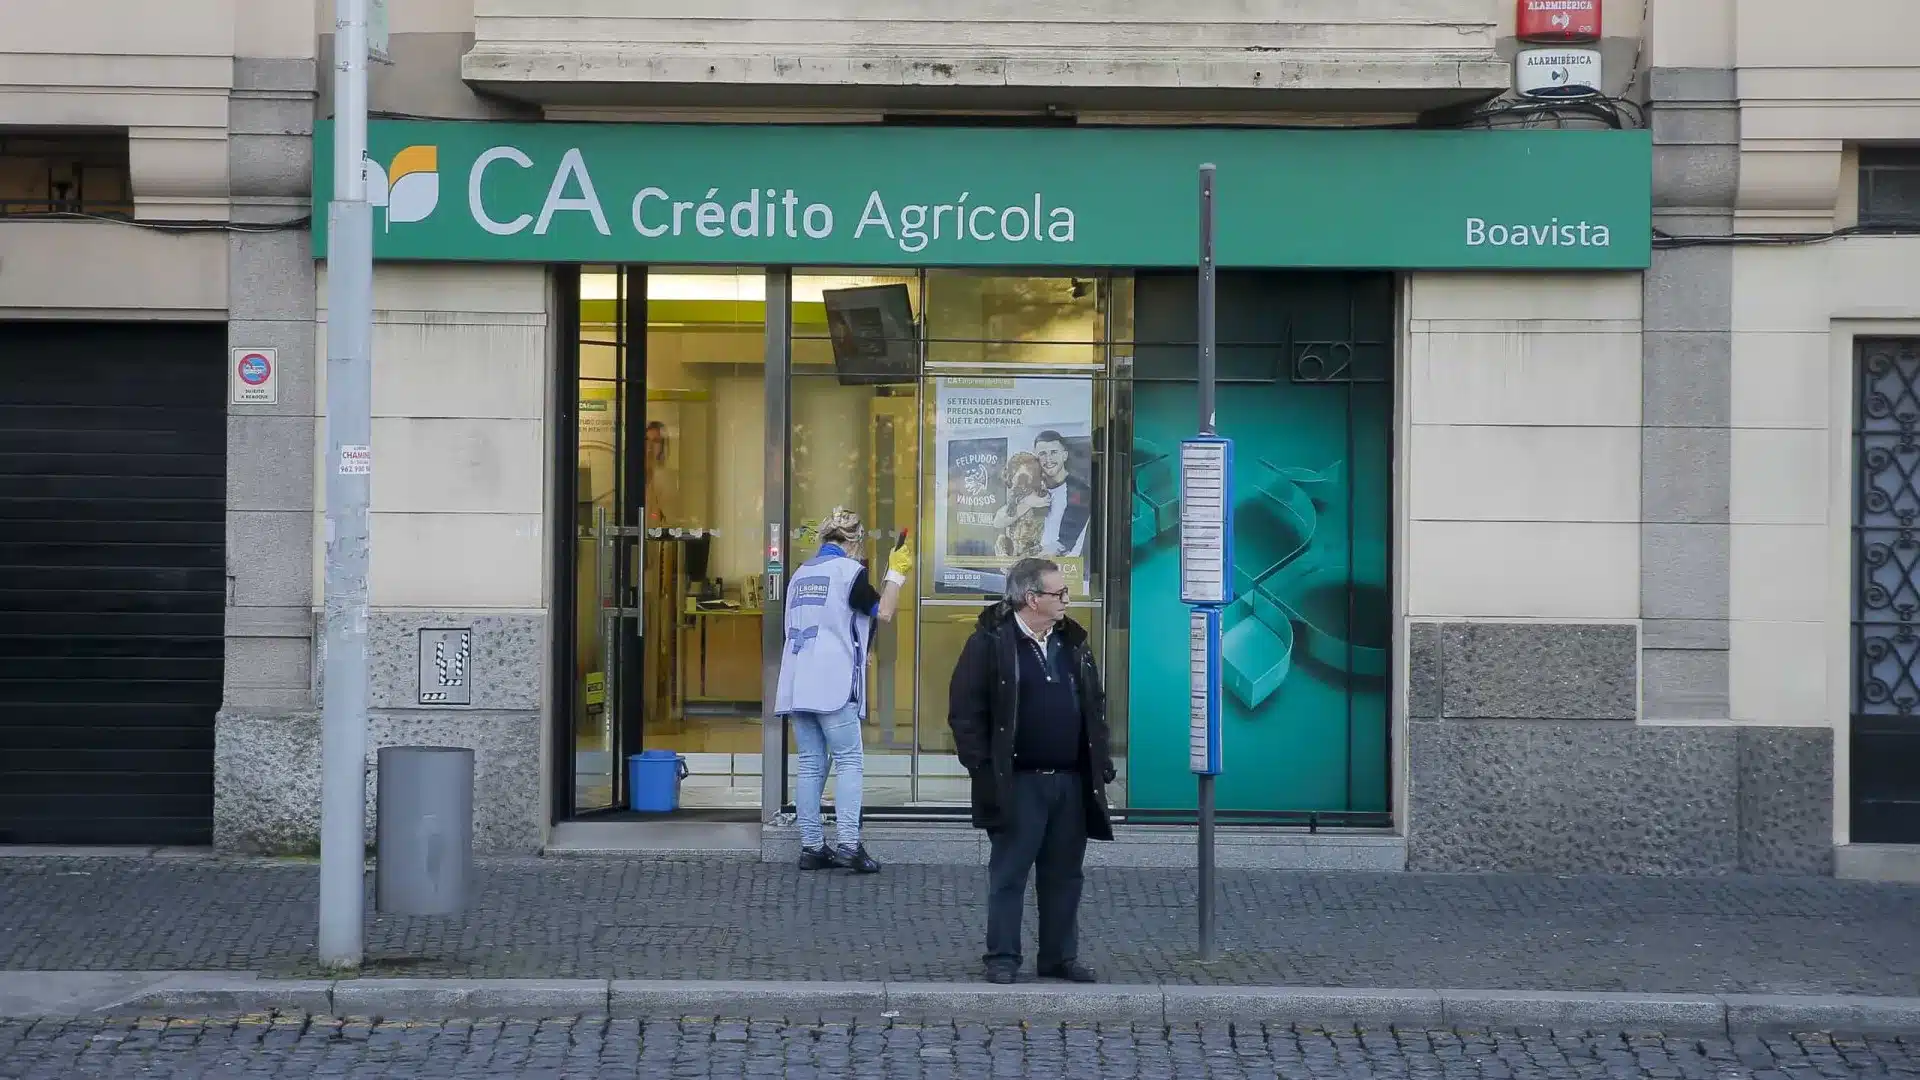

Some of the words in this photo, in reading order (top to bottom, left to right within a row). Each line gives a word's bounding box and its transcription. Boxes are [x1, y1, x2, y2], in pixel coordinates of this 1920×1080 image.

[1527, 53, 1592, 66] ALARMIBÉRICA
[468, 145, 612, 236] CA
[632, 186, 834, 239] Crédito
[853, 190, 1076, 253] Agrícola
[1466, 217, 1610, 246] Boavista
[978, 398, 1003, 406] IDEIAS
[955, 454, 998, 468] FELPUDOS
[956, 494, 996, 506] VAIDOSOS
